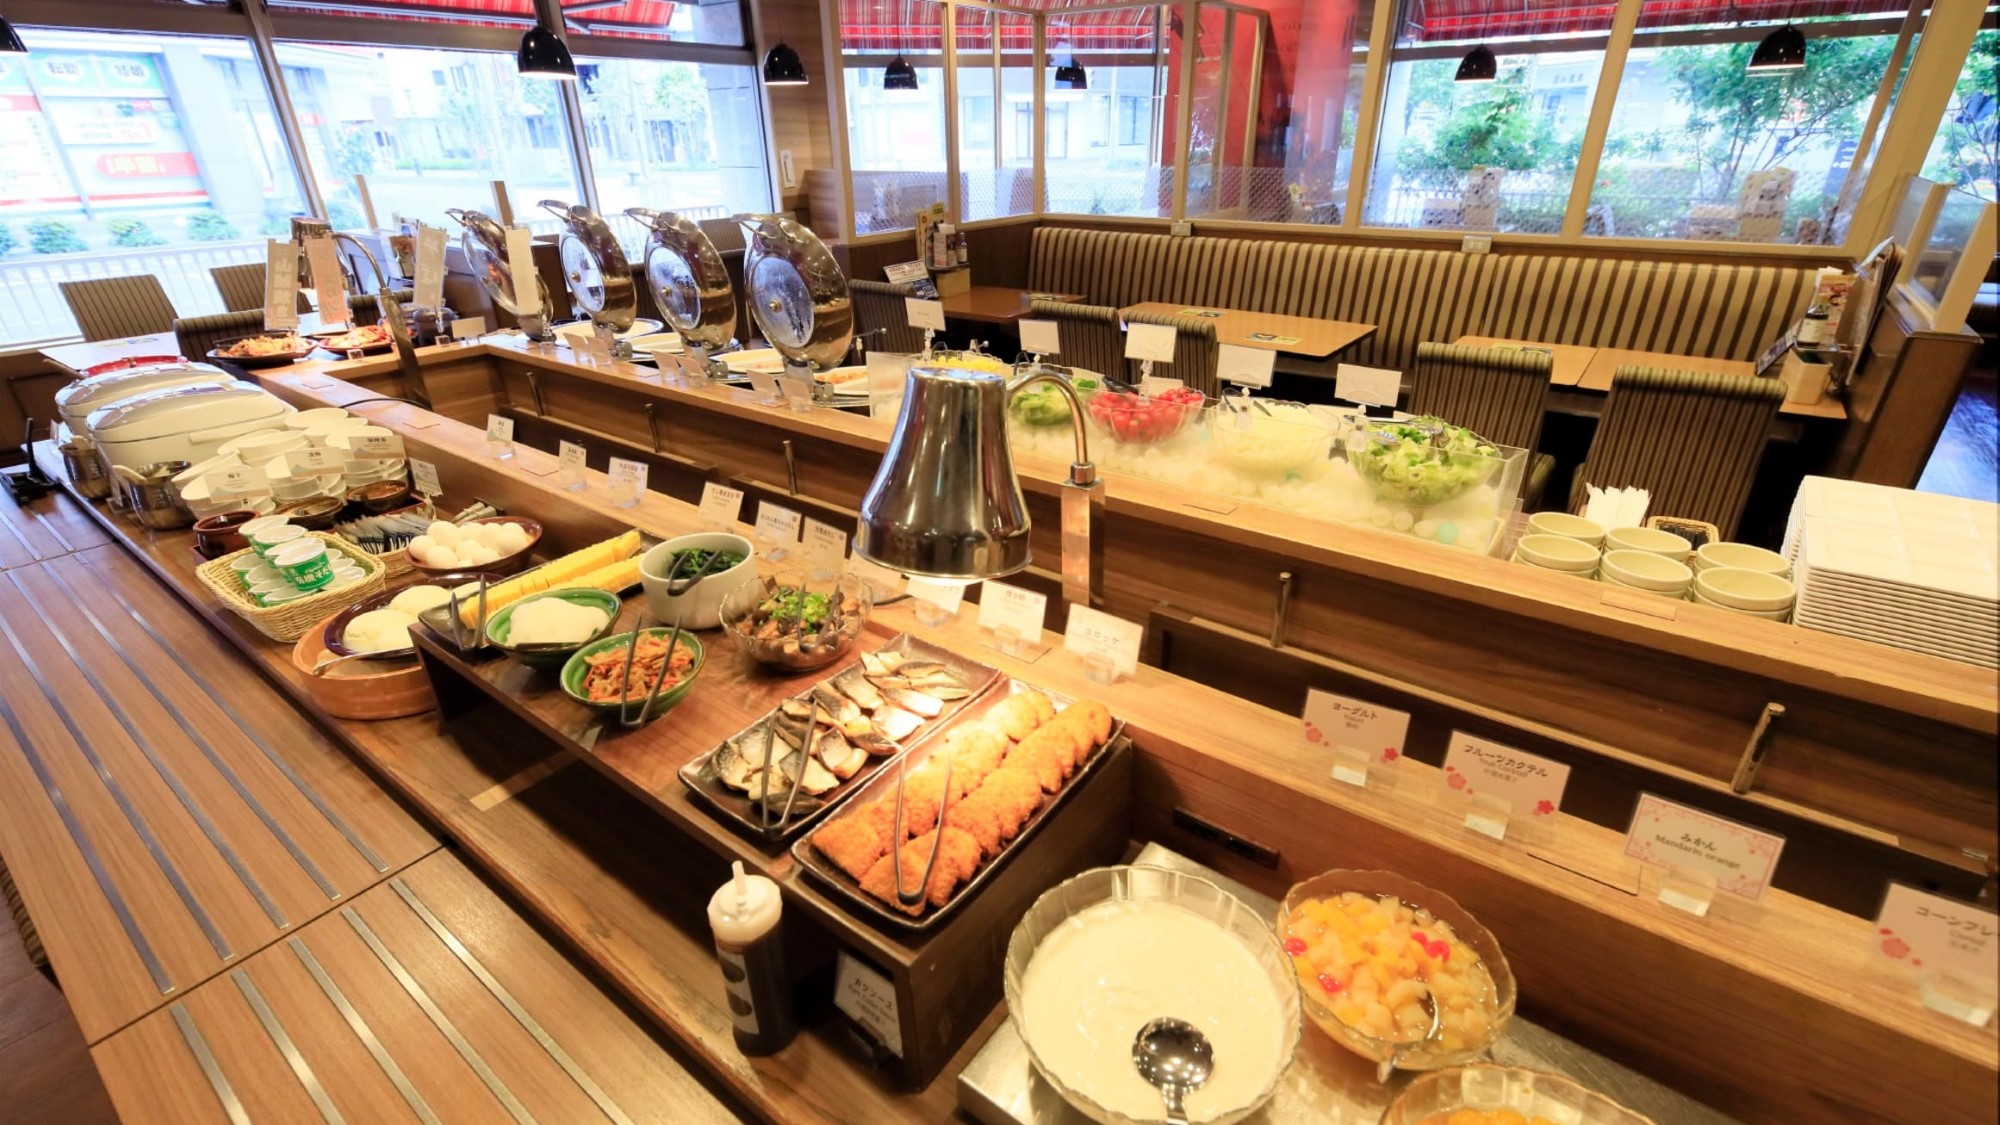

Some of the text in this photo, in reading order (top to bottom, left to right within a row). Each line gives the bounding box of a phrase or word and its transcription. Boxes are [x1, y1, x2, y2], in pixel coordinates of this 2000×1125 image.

[1084, 626, 1120, 646] コロッケ
[1332, 702, 1378, 720] ヨーグルト
[1463, 744, 1548, 777] フルーツカクテル
[1655, 834, 1742, 871] Mandarin orange
[1680, 832, 1717, 852] みかん
[1915, 905, 1999, 937] コーンフレ
[854, 977, 893, 1011] カツソース
